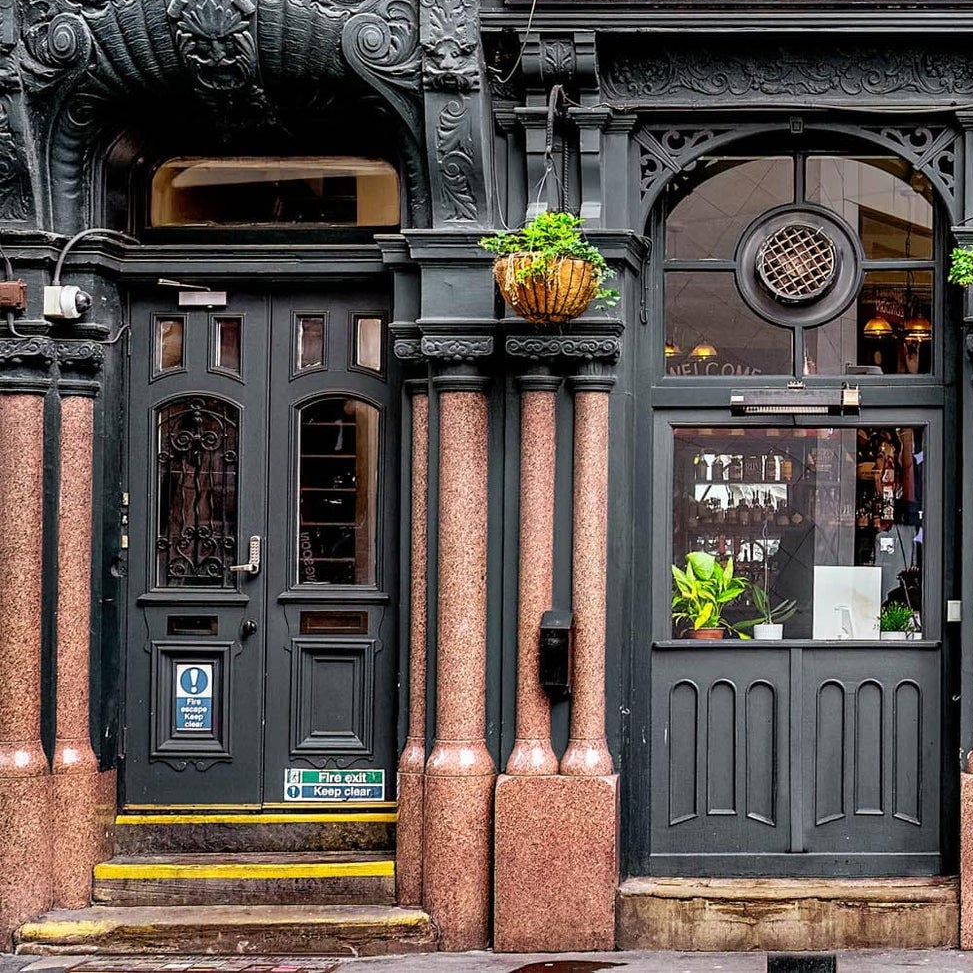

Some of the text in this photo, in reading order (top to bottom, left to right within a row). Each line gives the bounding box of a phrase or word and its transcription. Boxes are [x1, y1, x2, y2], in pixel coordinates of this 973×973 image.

[181, 706, 208, 714] escape
[184, 713, 204, 721] Keep
[184, 720, 204, 728] clear
[318, 772, 367, 783] Fire exit
[313, 786, 371, 797] Keep clear
